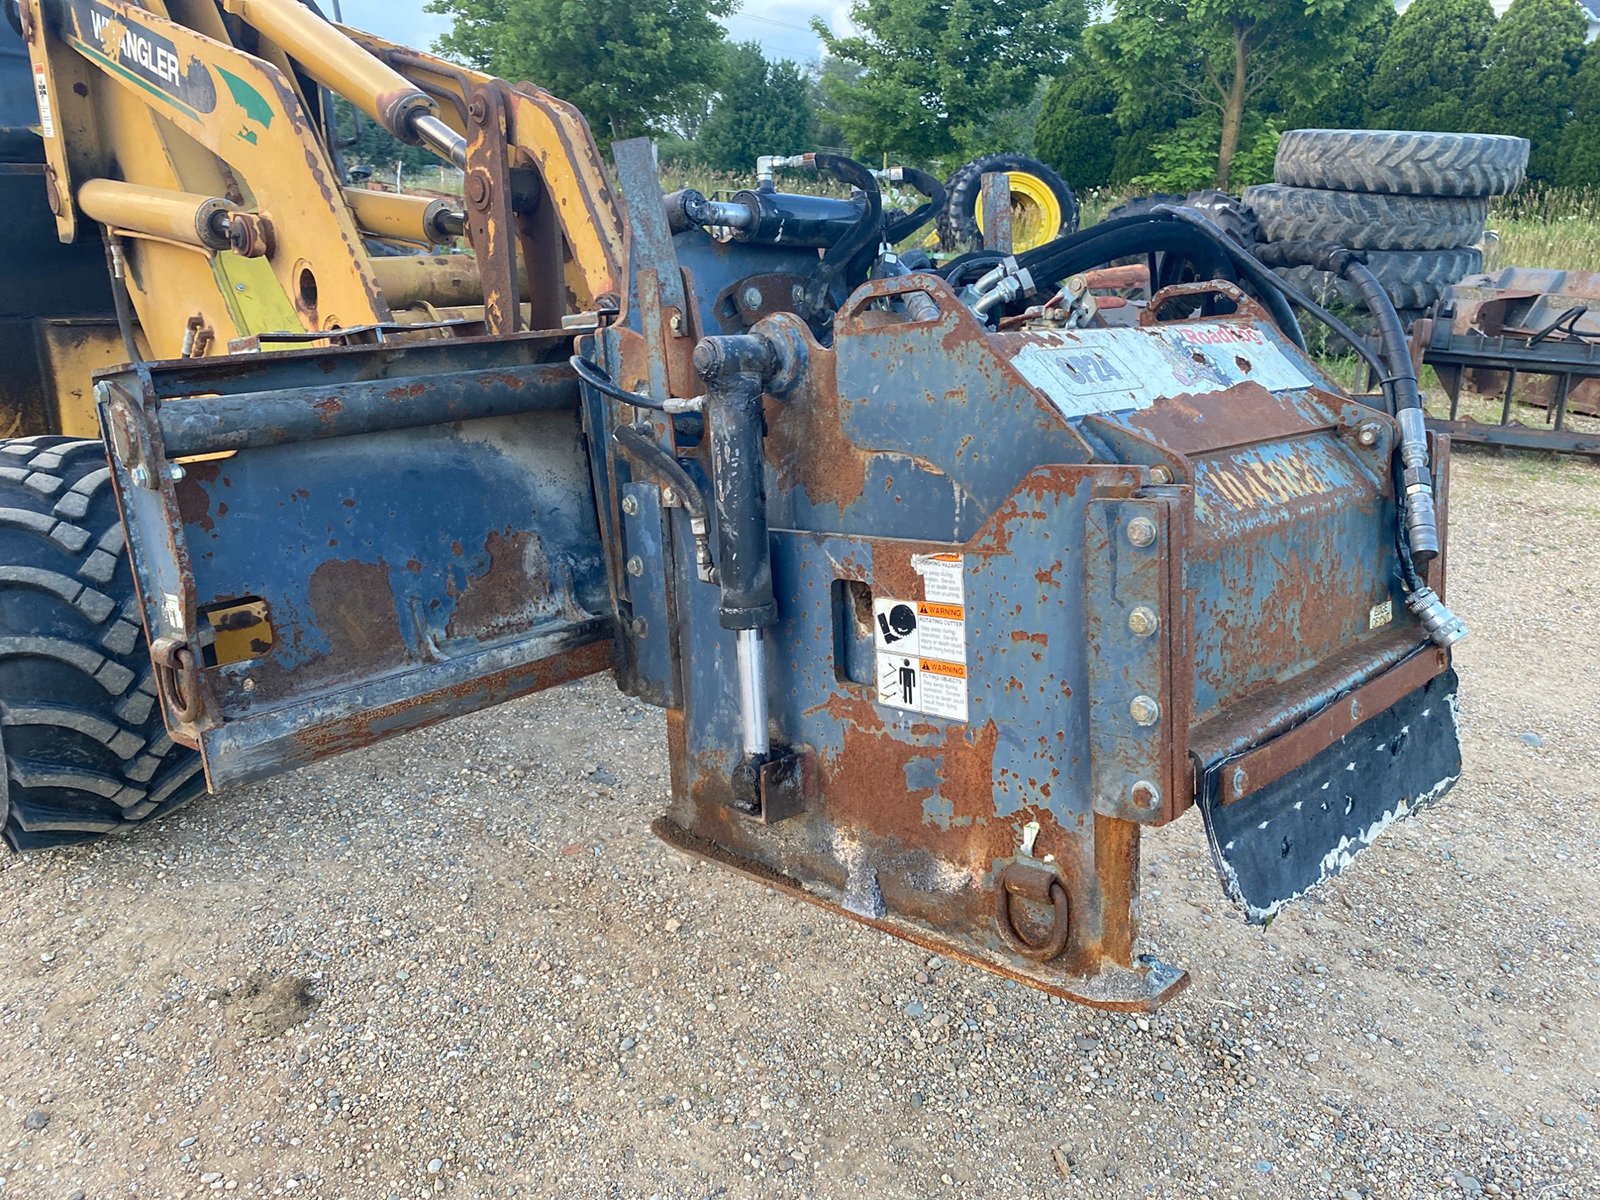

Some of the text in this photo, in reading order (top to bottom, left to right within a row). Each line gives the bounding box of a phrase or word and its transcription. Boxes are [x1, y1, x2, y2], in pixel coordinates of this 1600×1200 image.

[90, 9, 180, 87] WANGLER
[1055, 354, 1124, 385] CP24
[929, 606, 961, 617] WARNING
[919, 617, 943, 625] ROTATING
[931, 663, 963, 675] WARNING
[922, 673, 962, 684] FLYING OBJECTS
